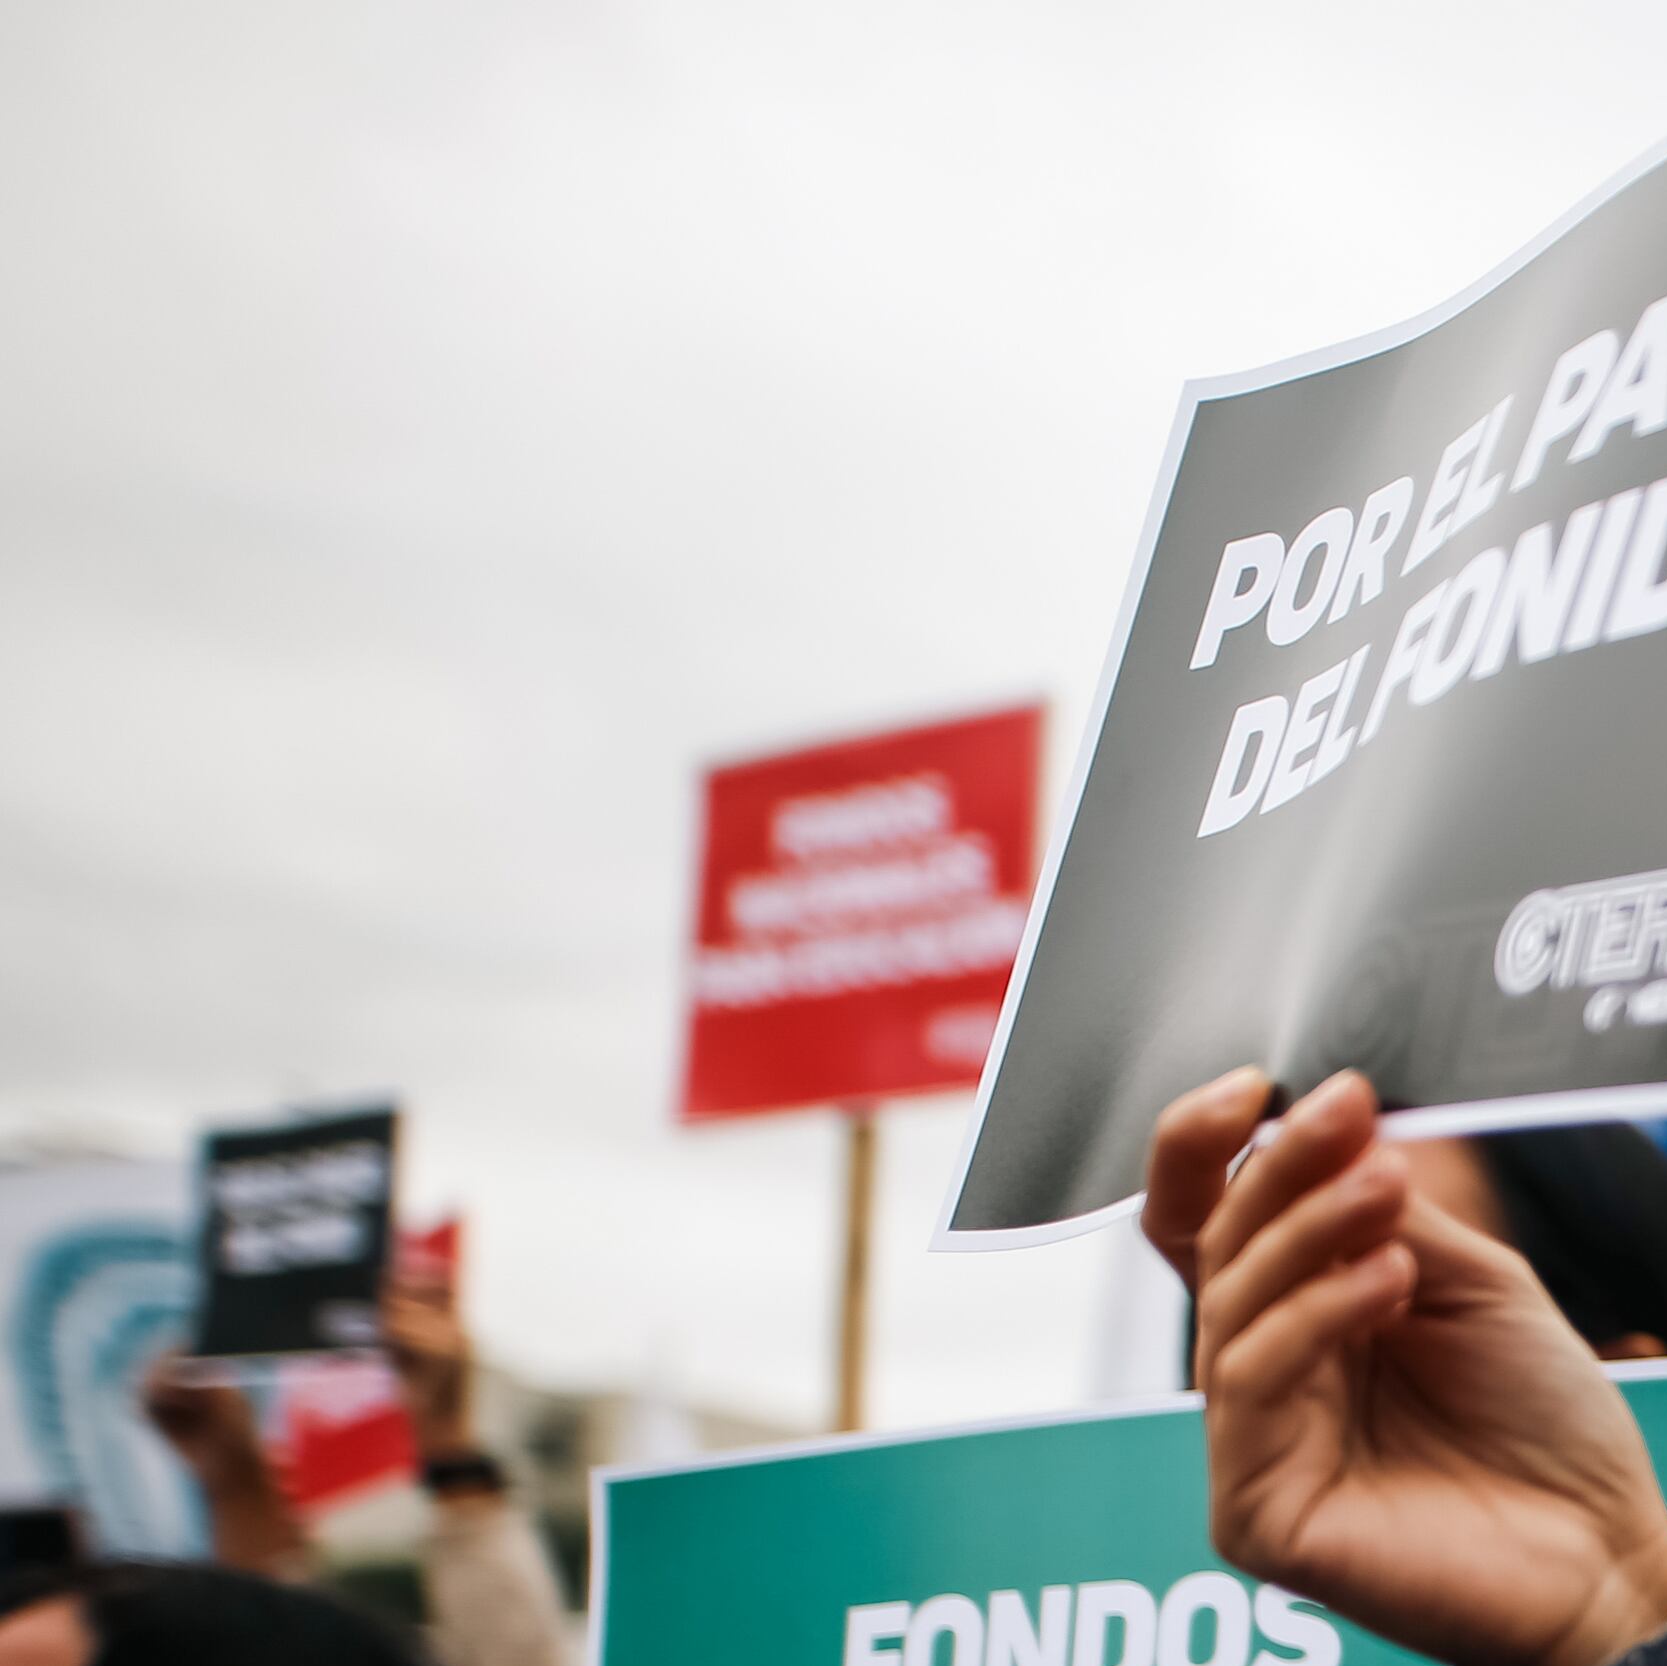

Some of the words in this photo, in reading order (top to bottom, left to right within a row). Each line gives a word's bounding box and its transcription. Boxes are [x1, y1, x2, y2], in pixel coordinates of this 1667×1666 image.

[1189, 474, 1413, 670] POR
[1401, 393, 1516, 577] EL
[1197, 643, 1372, 838] DEL
